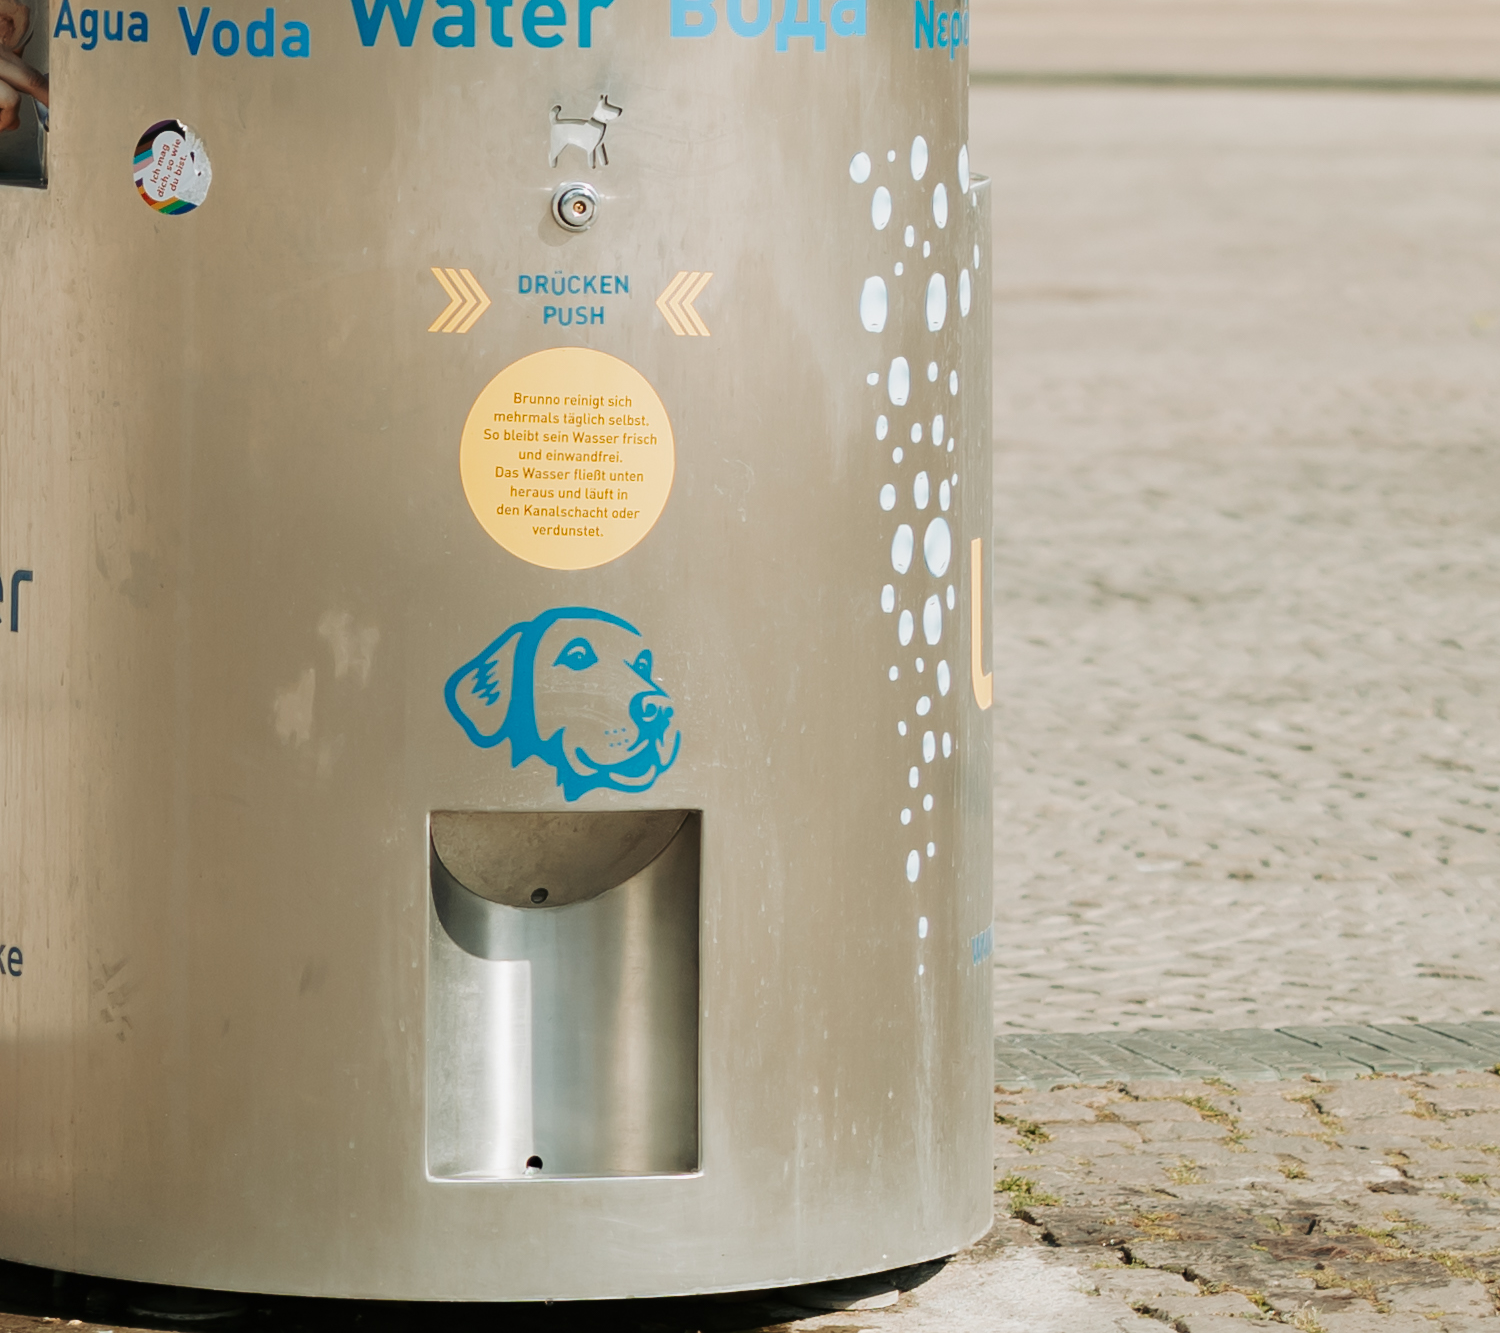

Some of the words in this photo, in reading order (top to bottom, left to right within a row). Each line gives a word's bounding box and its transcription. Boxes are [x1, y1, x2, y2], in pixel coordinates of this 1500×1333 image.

[177, 6, 311, 59] Voda
[150, 167, 161, 184] Ich
[157, 143, 170, 167] mag
[156, 174, 171, 198] dich,
[166, 159, 175, 171] so
[171, 138, 182, 157] wie
[173, 154, 188, 176] bist.
[170, 177, 180, 192] du
[518, 269, 630, 296] DRÜCKEN
[542, 305, 606, 327] PUSH
[513, 391, 560, 405] Brunno
[564, 394, 605, 410] reinigt
[607, 394, 633, 408] sich
[493, 410, 560, 425] mehrmals
[563, 412, 605, 428] täglich
[608, 414, 650, 427] selbst.
[483, 428, 500, 440] So
[503, 429, 539, 442] bleibt
[542, 430, 569, 443] sein
[572, 431, 620, 444] Wasser
[622, 432, 658, 446] frisch
[518, 448, 542, 461] und
[545, 448, 623, 463] einwandfrei.
[495, 466, 519, 479] Das
[522, 466, 571, 480] Wasser
[573, 468, 606, 481] fließt
[609, 470, 644, 482] unten
[510, 485, 555, 499] heraus
[558, 487, 582, 500] und
[585, 487, 614, 500] läuft
[617, 488, 629, 500] in
[496, 503, 520, 516] den
[523, 504, 609, 519] Kanalschacht
[611, 507, 641, 519] oder
[532, 524, 604, 537] verdunstet.
